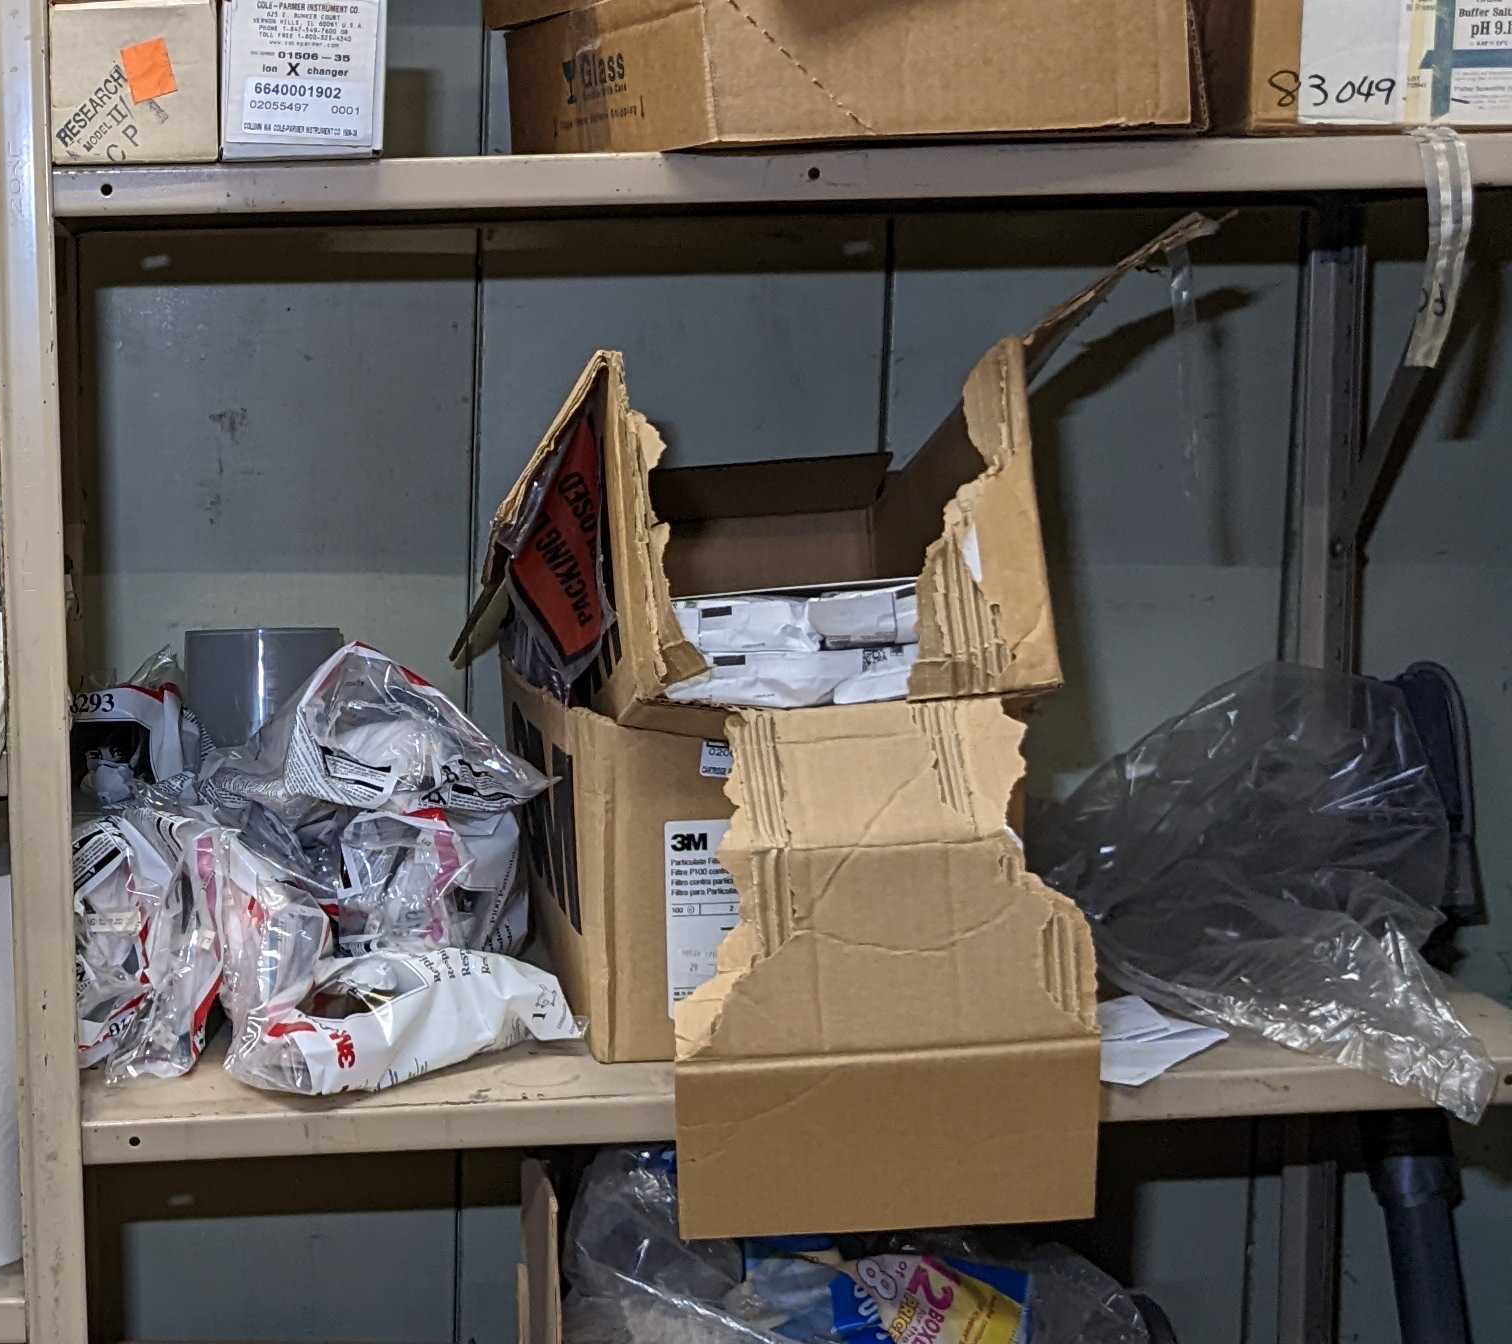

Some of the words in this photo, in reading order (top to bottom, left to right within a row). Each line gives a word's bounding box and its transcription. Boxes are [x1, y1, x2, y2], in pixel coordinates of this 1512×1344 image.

[1459, 8, 1488, 17] Buffer
[1471, 20, 1491, 38] pH
[278, 51, 319, 60] 01506
[333, 53, 350, 62] 35
[286, 62, 300, 78] X
[307, 66, 349, 78] changer
[581, 53, 625, 89] Glass
[254, 83, 342, 99] 6640001902
[56, 63, 127, 147] RESEARCH
[250, 101, 309, 112] 02055497
[331, 105, 360, 115] 0001
[83, 122, 113, 153] MODEL
[671, 833, 708, 851] 3M
[856, 1258, 898, 1300] 8
[906, 1265, 954, 1311] 2
